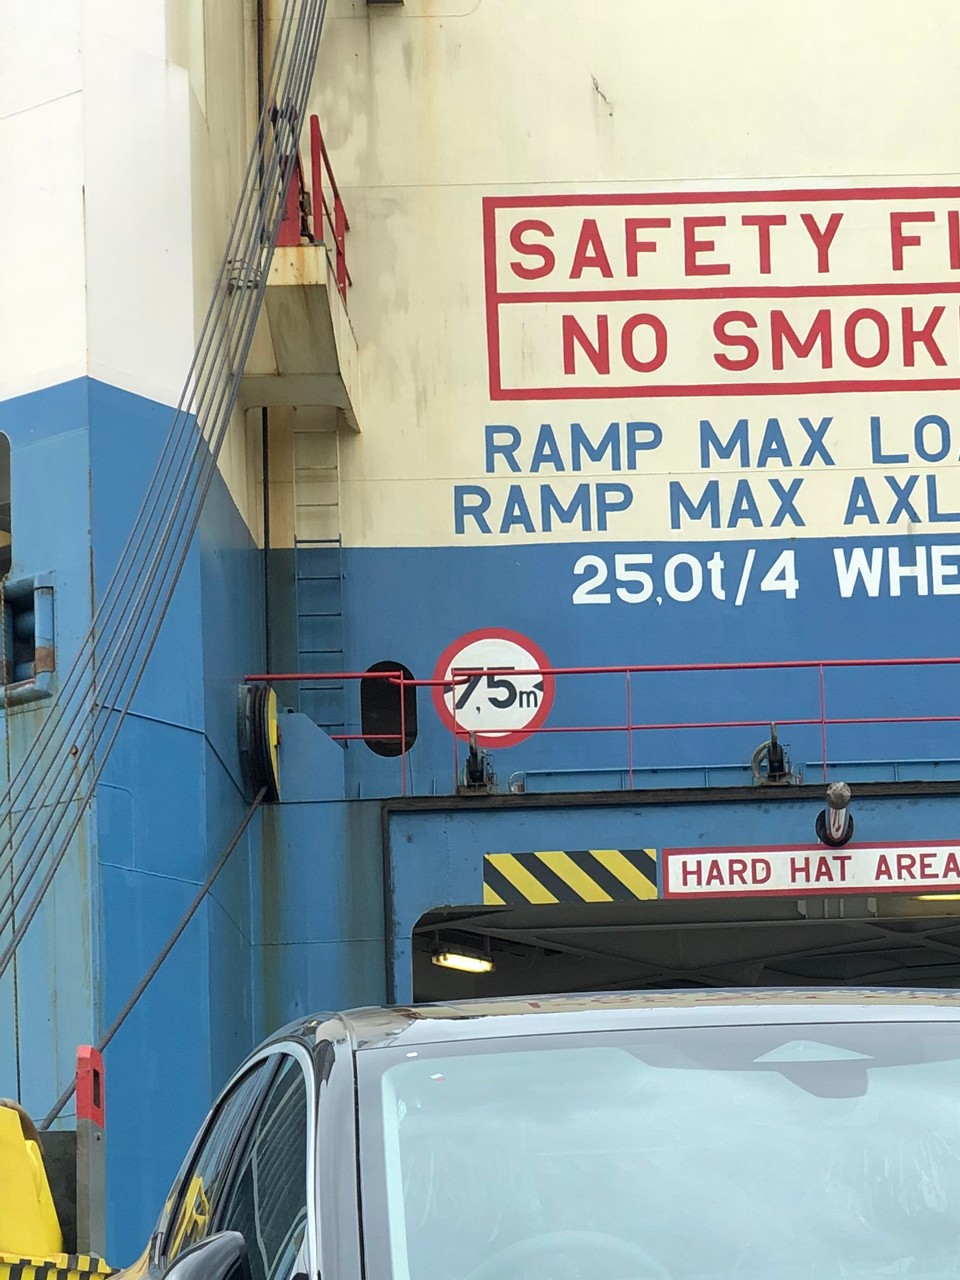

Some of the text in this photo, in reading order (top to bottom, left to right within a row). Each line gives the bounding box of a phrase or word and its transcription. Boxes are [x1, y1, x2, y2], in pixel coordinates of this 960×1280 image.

[509, 212, 844, 280] SAFETY
[562, 313, 668, 375] NO
[484, 421, 663, 473] RAMP
[699, 417, 835, 469] MAX
[453, 482, 634, 534] RAMP
[669, 478, 804, 530] MAX
[681, 858, 772, 887] HARD
[790, 855, 852, 883] HAT
